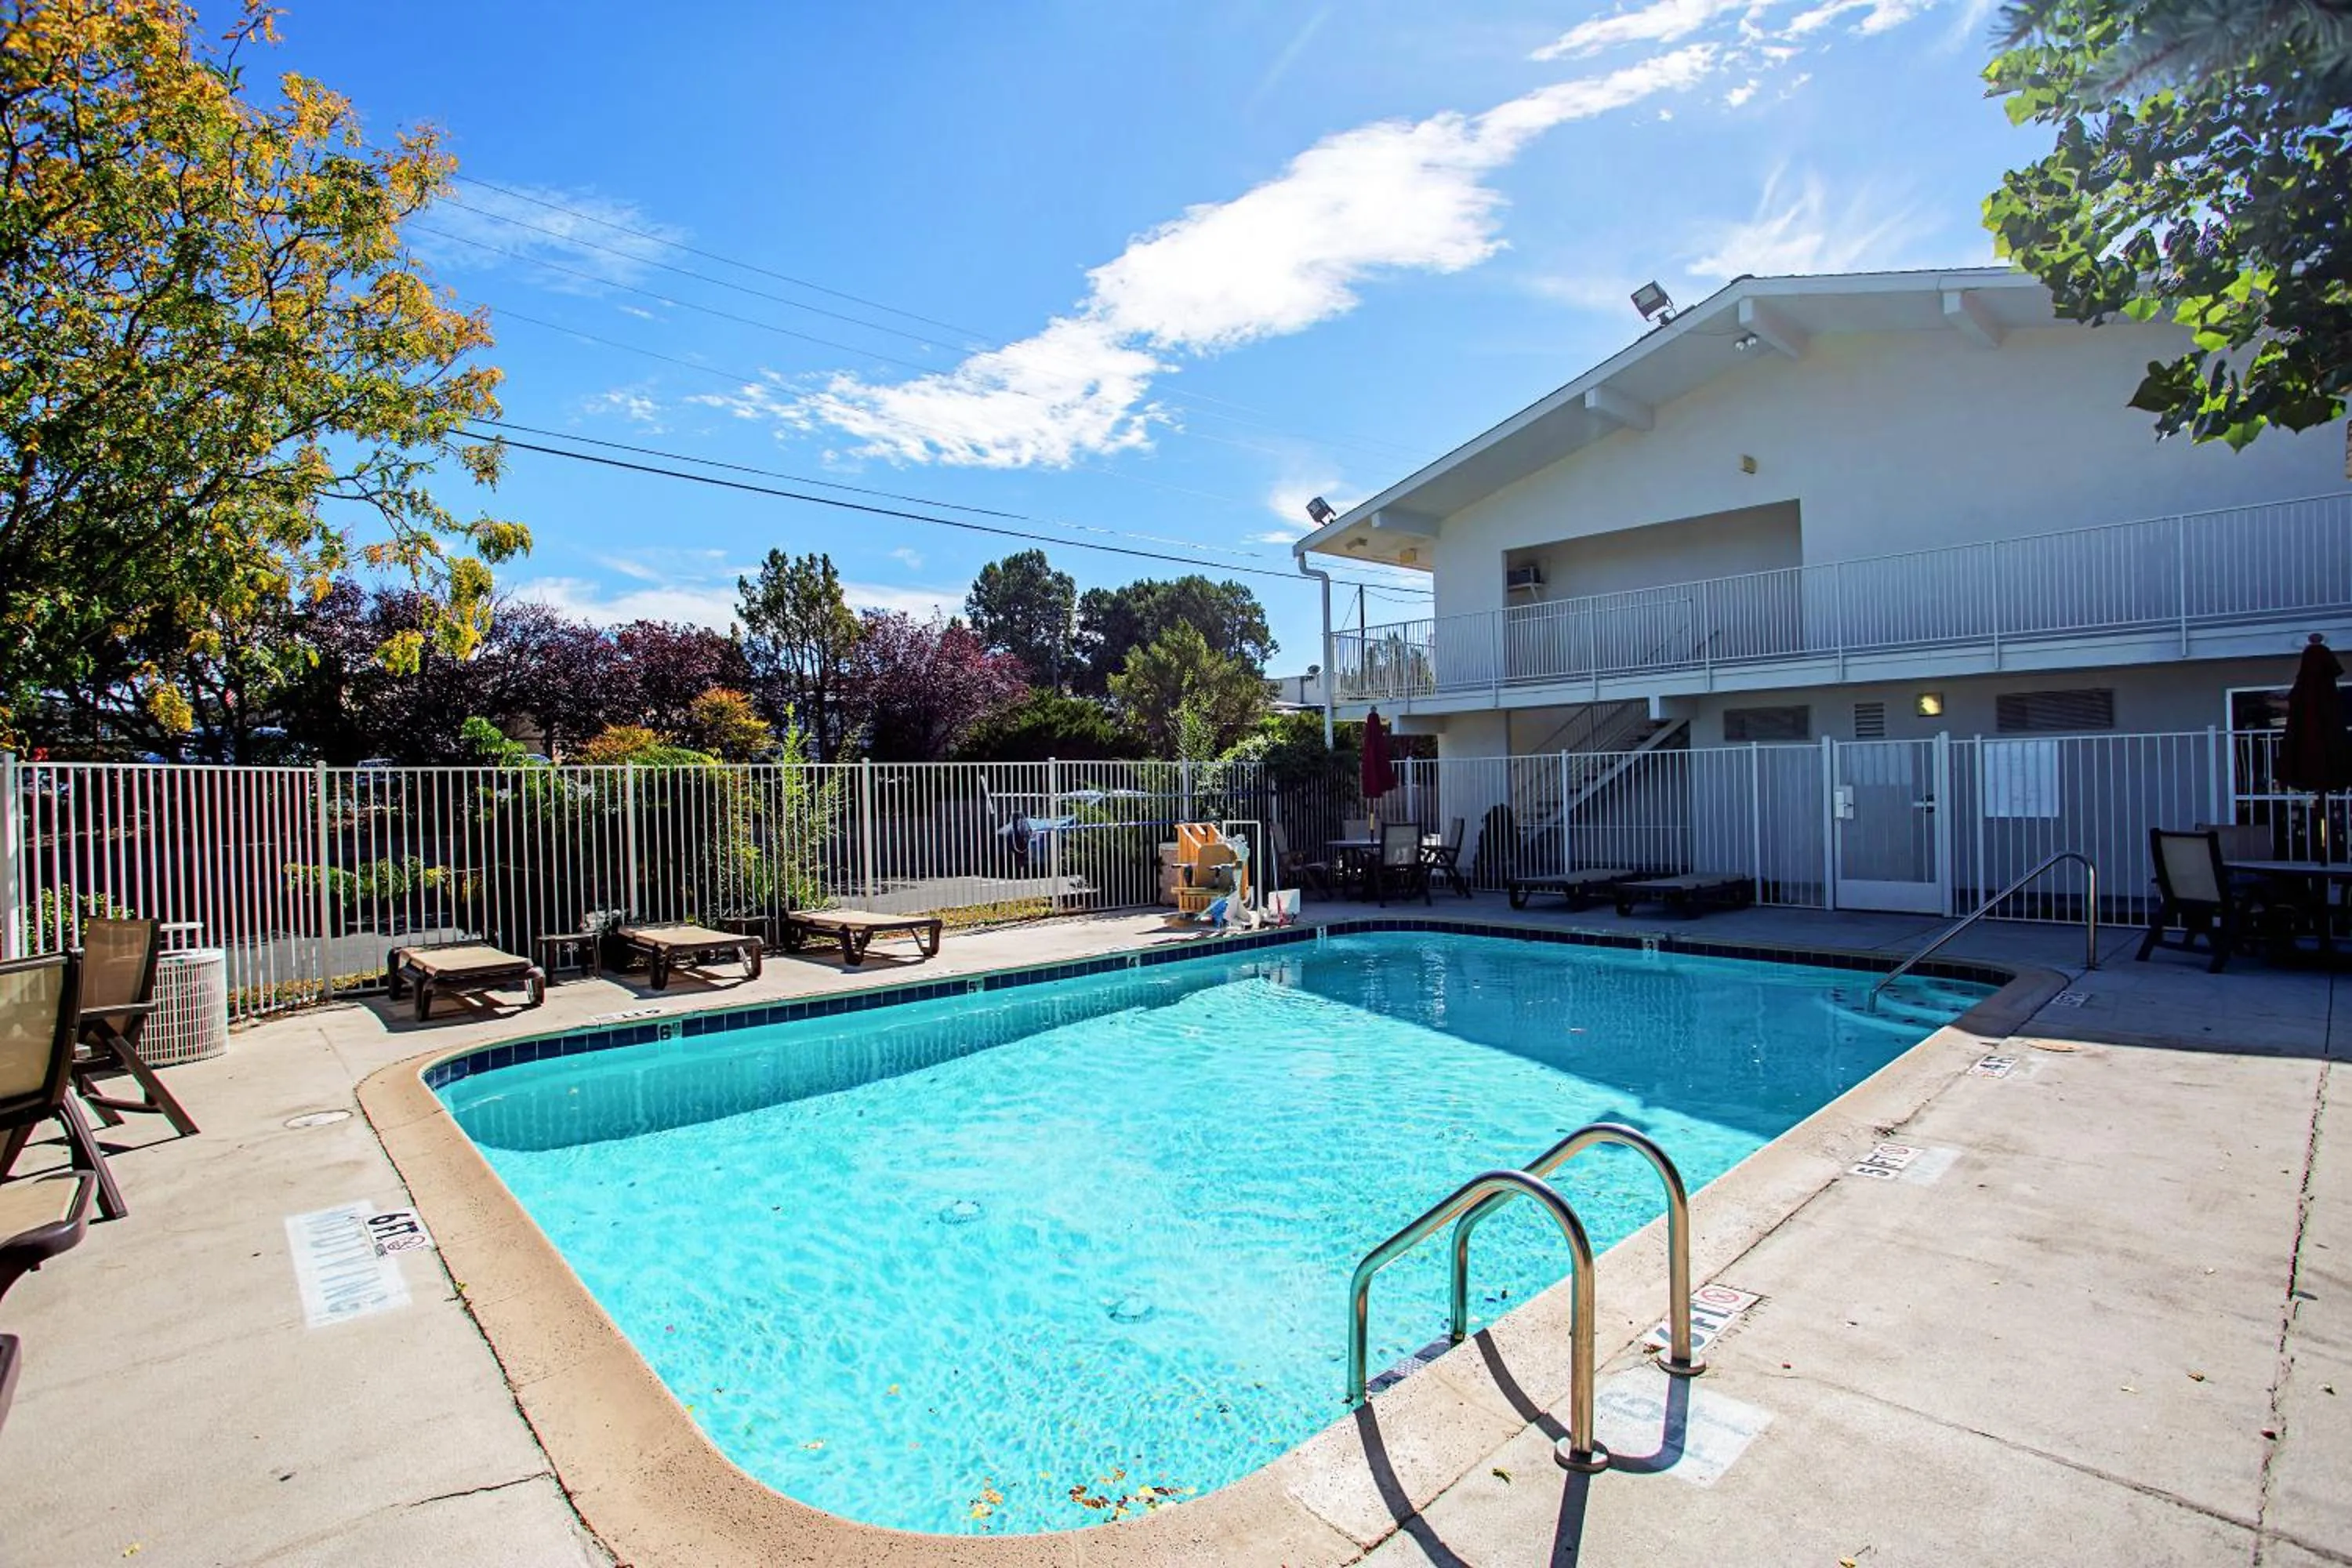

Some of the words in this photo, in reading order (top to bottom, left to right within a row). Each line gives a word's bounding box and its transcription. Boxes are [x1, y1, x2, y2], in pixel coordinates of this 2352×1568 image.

[967, 981, 977, 993] 5
[659, 1024, 672, 1040] 6
[1857, 1167, 1890, 1177] 5
[368, 1213, 411, 1225] 6
